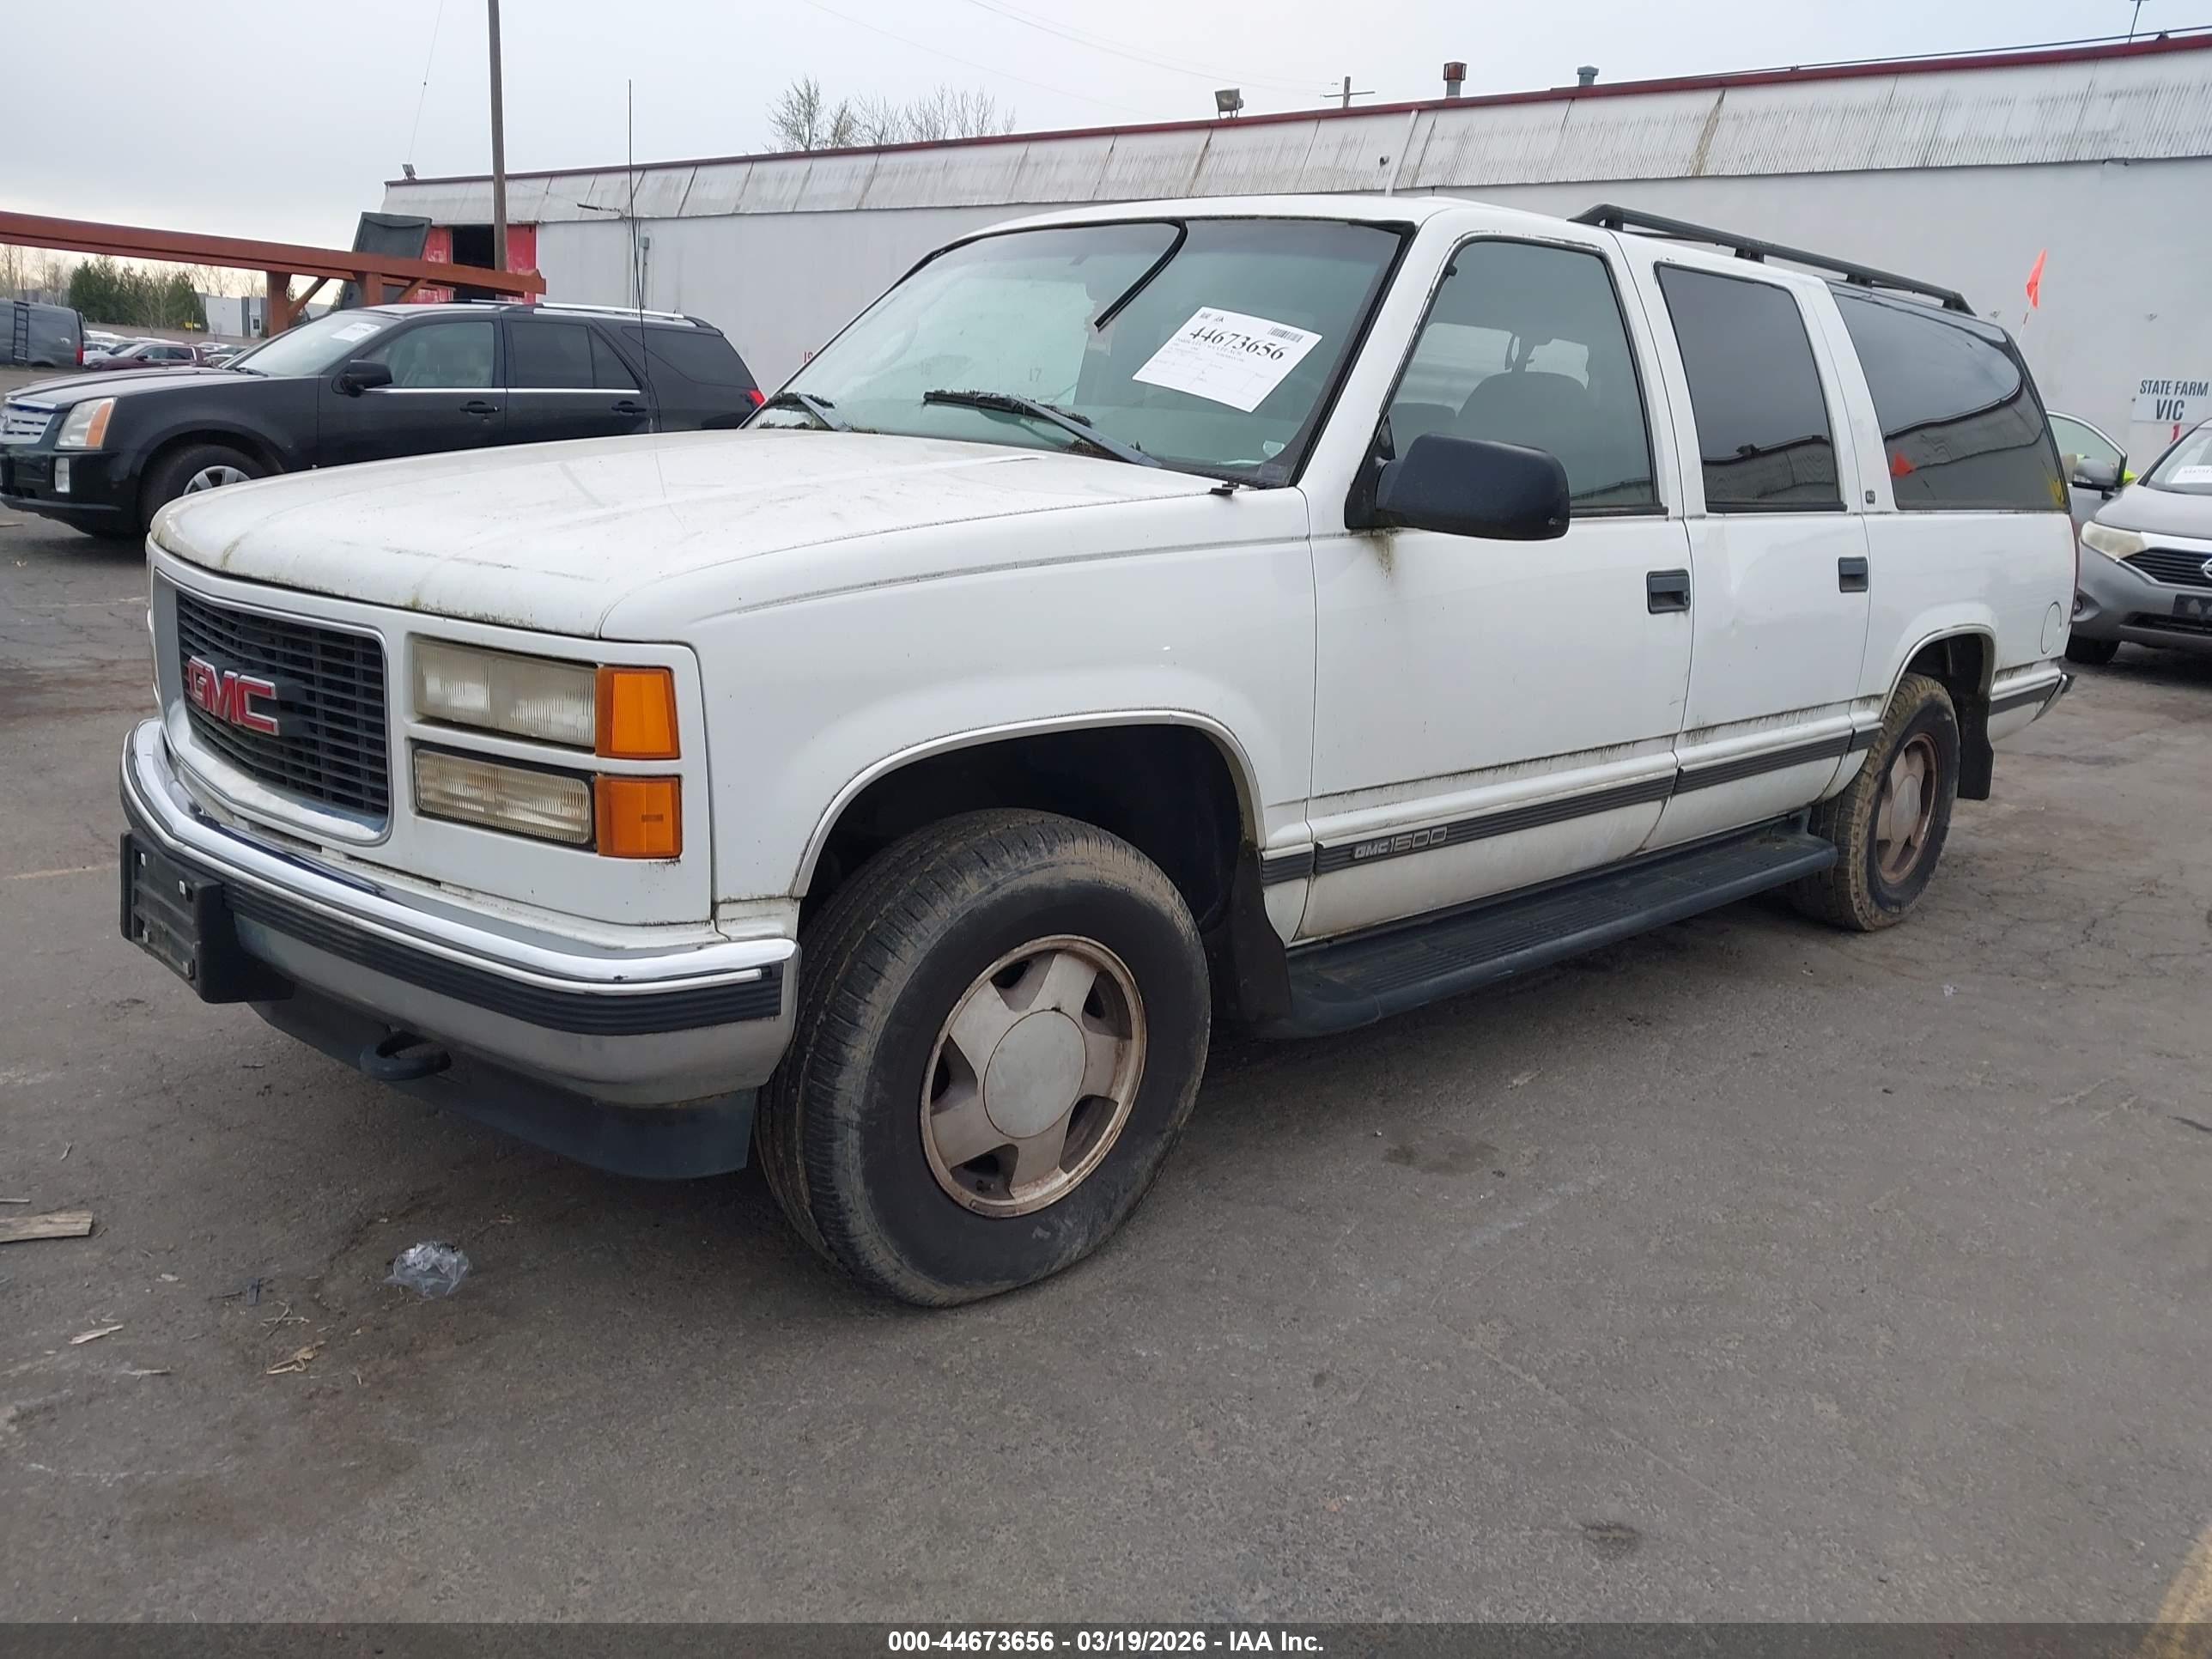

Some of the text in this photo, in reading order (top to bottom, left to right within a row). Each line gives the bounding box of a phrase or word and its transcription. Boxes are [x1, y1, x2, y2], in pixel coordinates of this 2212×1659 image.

[1189, 326, 1291, 360] 44673656
[2139, 380, 2209, 397] STATE FARM
[2156, 398, 2185, 421] VIC
[187, 655, 280, 736] GMC
